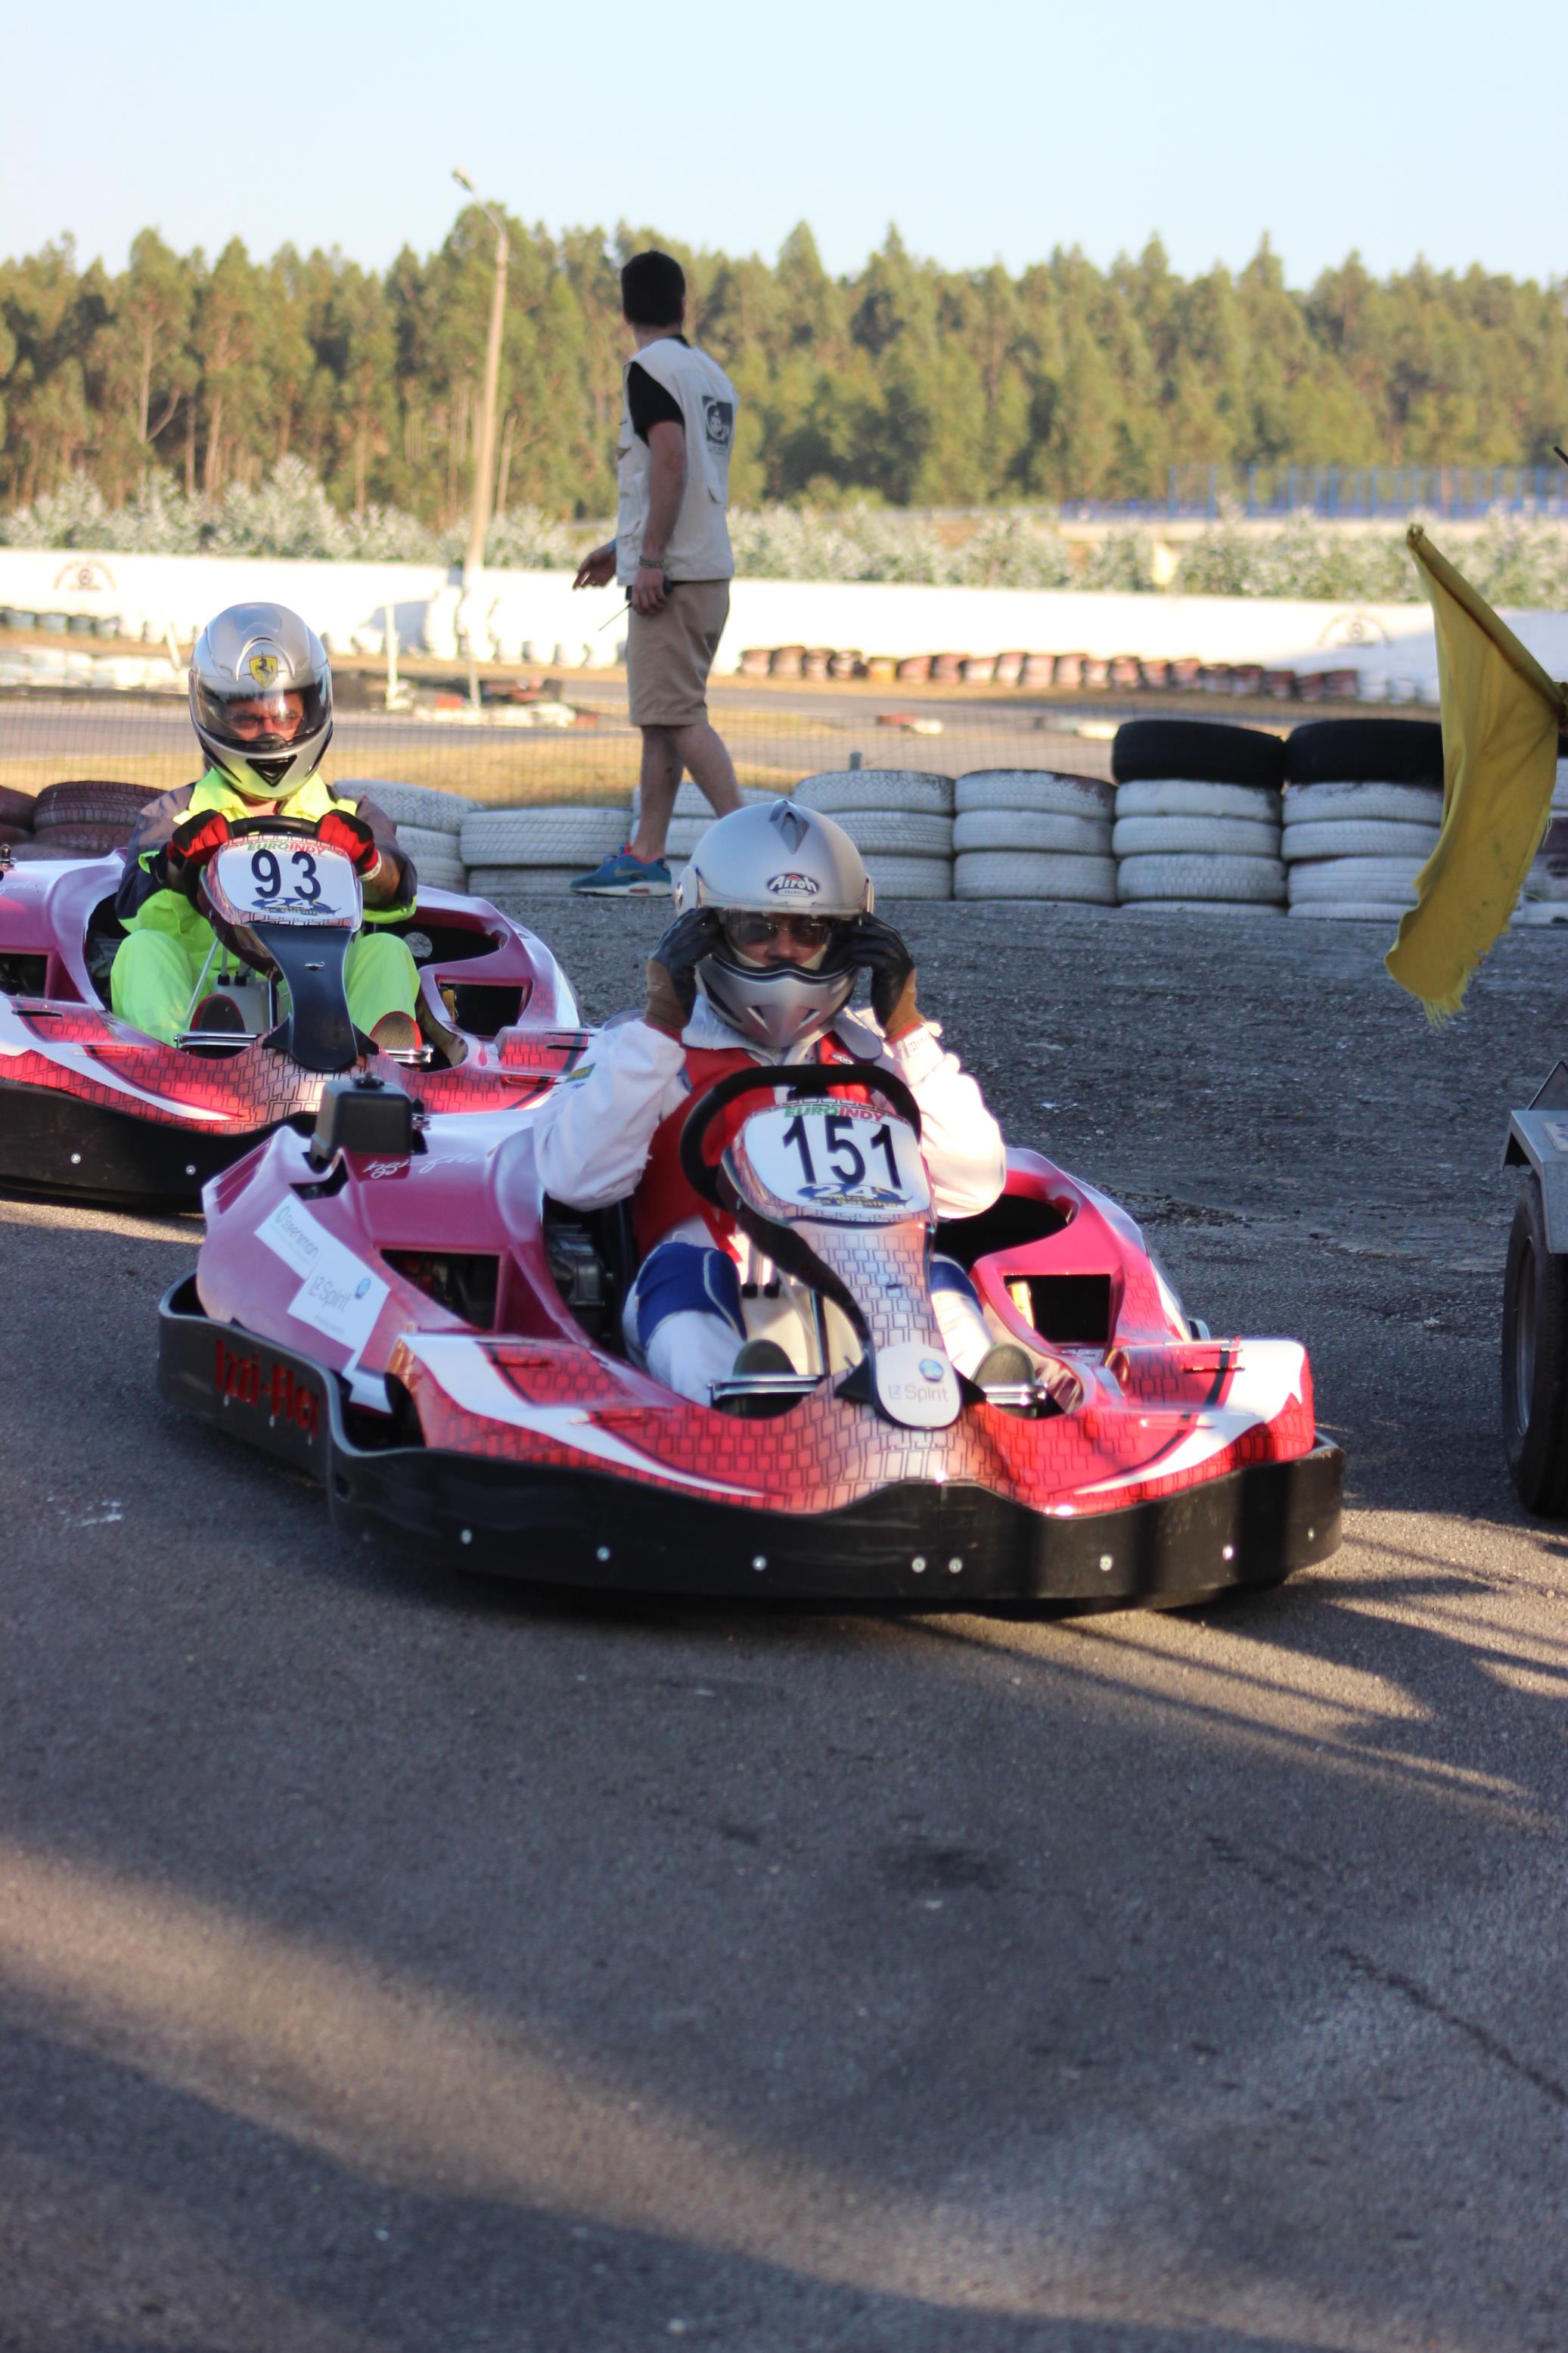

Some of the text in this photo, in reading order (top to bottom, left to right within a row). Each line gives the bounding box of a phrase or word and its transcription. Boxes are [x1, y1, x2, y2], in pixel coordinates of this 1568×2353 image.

[251, 849, 321, 900] 93
[768, 875, 817, 893] Airoh
[263, 897, 314, 909] 24
[784, 1105, 885, 1122] EUROINDY
[782, 1114, 903, 1191] 151
[812, 1183, 878, 1200] 24
[905, 1384, 949, 1405] Spirit
